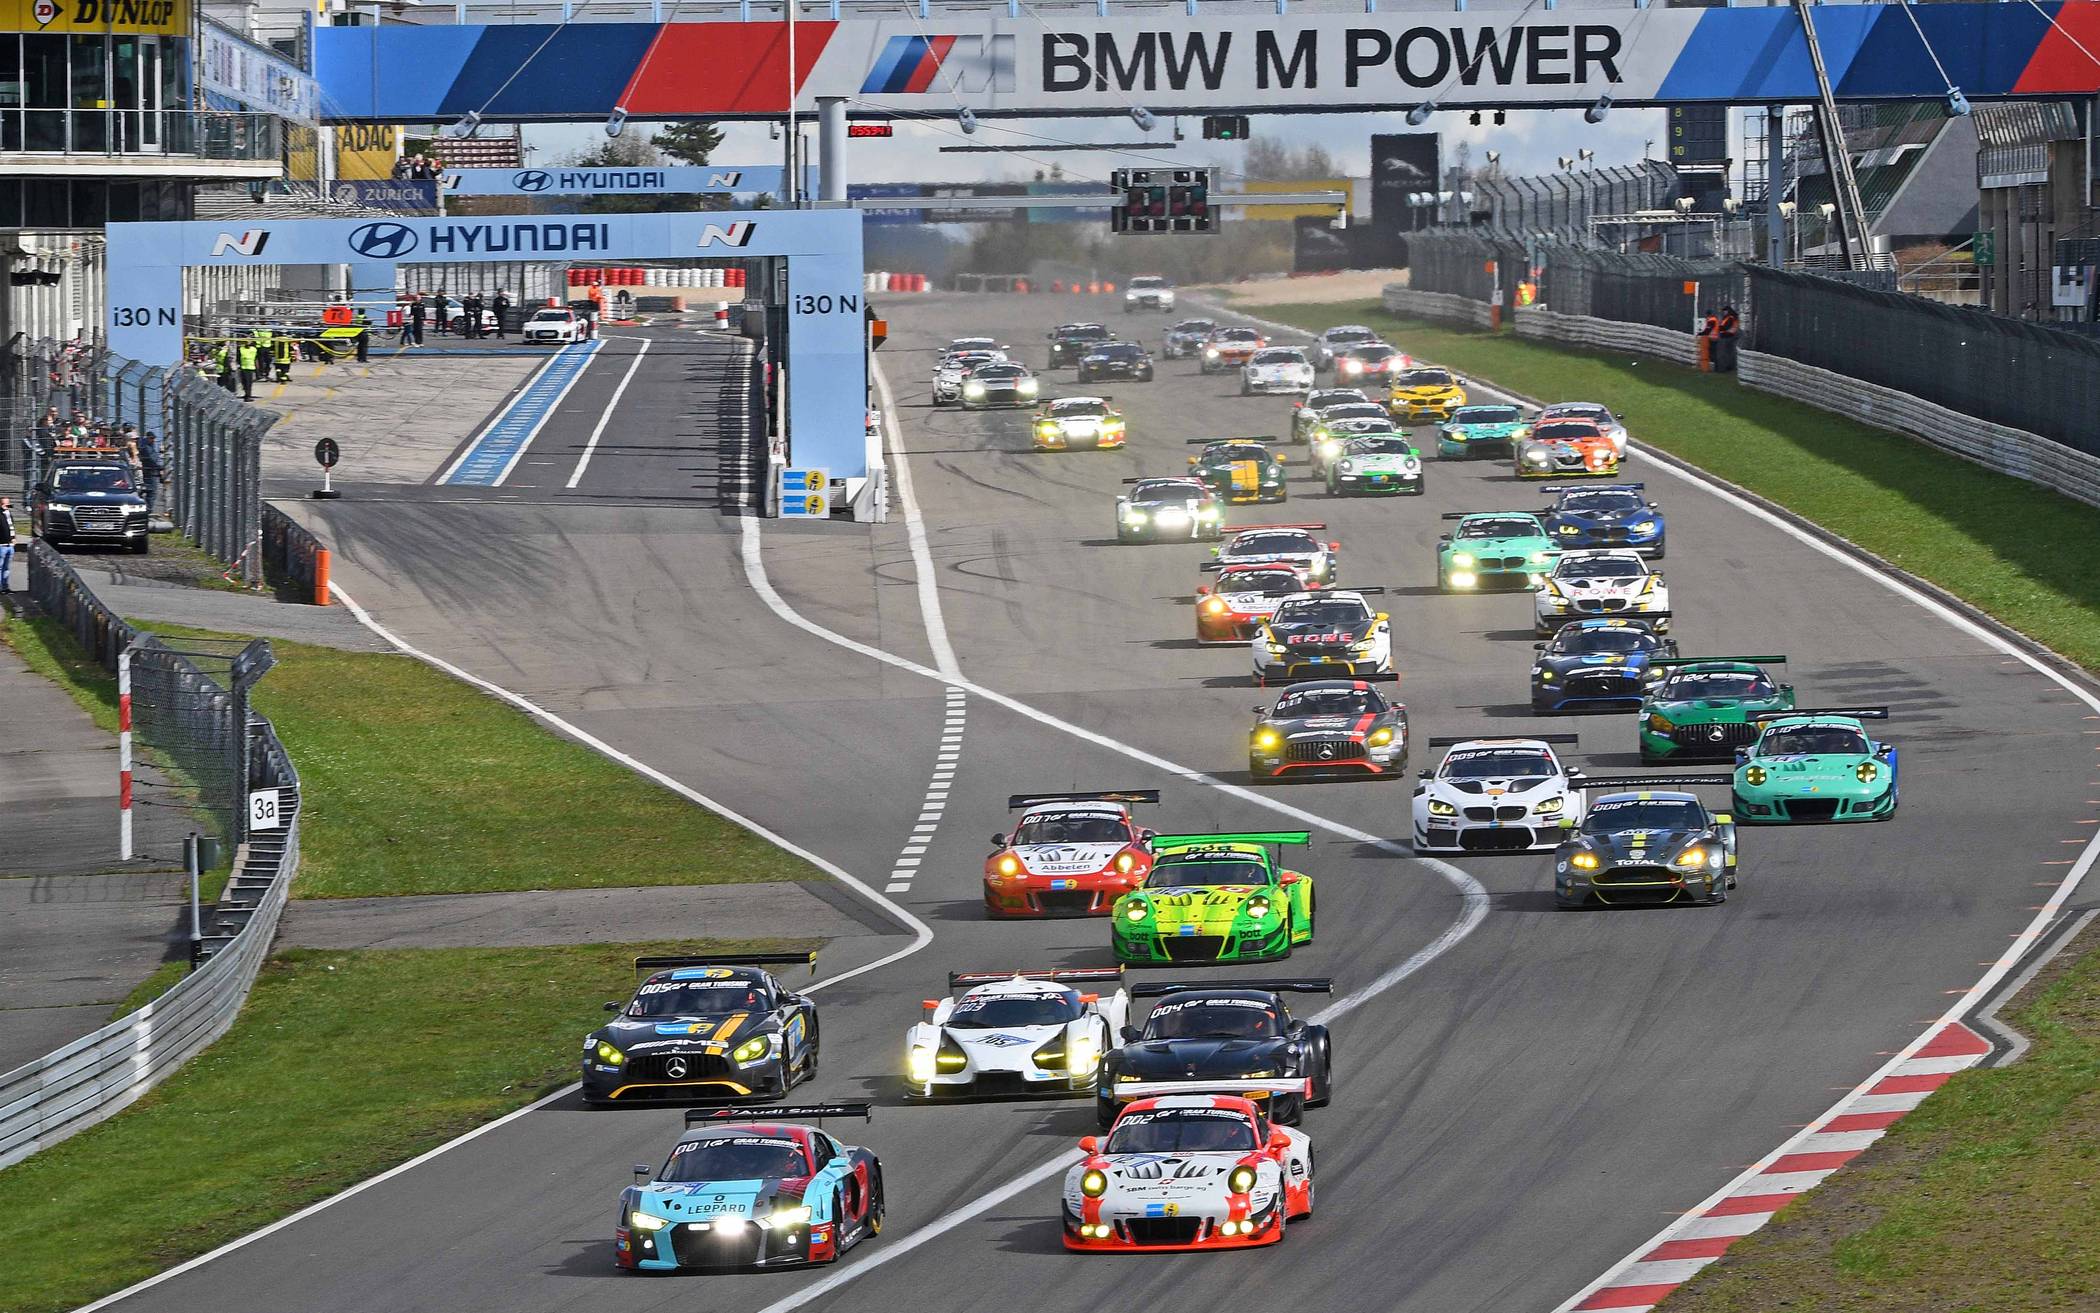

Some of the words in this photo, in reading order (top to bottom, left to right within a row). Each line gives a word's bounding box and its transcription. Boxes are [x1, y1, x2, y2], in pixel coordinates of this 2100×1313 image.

[73, 0, 174, 25] DUNLOP
[1042, 31, 1232, 92] BMW
[1256, 29, 1317, 89] M
[1345, 24, 1623, 88] POWER
[1675, 107, 1682, 117] 8
[1675, 126, 1683, 137] 9
[343, 125, 393, 152] ADAC
[1672, 145, 1685, 156] 10
[560, 172, 664, 189] HYUNDAI
[430, 223, 609, 253] HYUNDAI
[796, 294, 832, 315] i30
[839, 294, 857, 314] N
[114, 306, 151, 328] i30
[158, 306, 176, 327] N
[1572, 587, 1632, 597] ROWE
[254, 797, 275, 820] 3a
[1041, 863, 1091, 871] Abbelen
[1239, 929, 1262, 939] bott
[737, 1108, 783, 1116] Audi
[788, 1106, 845, 1115] Sport
[1118, 1114, 1155, 1126] 002
[688, 1204, 746, 1215] LEOPARD
